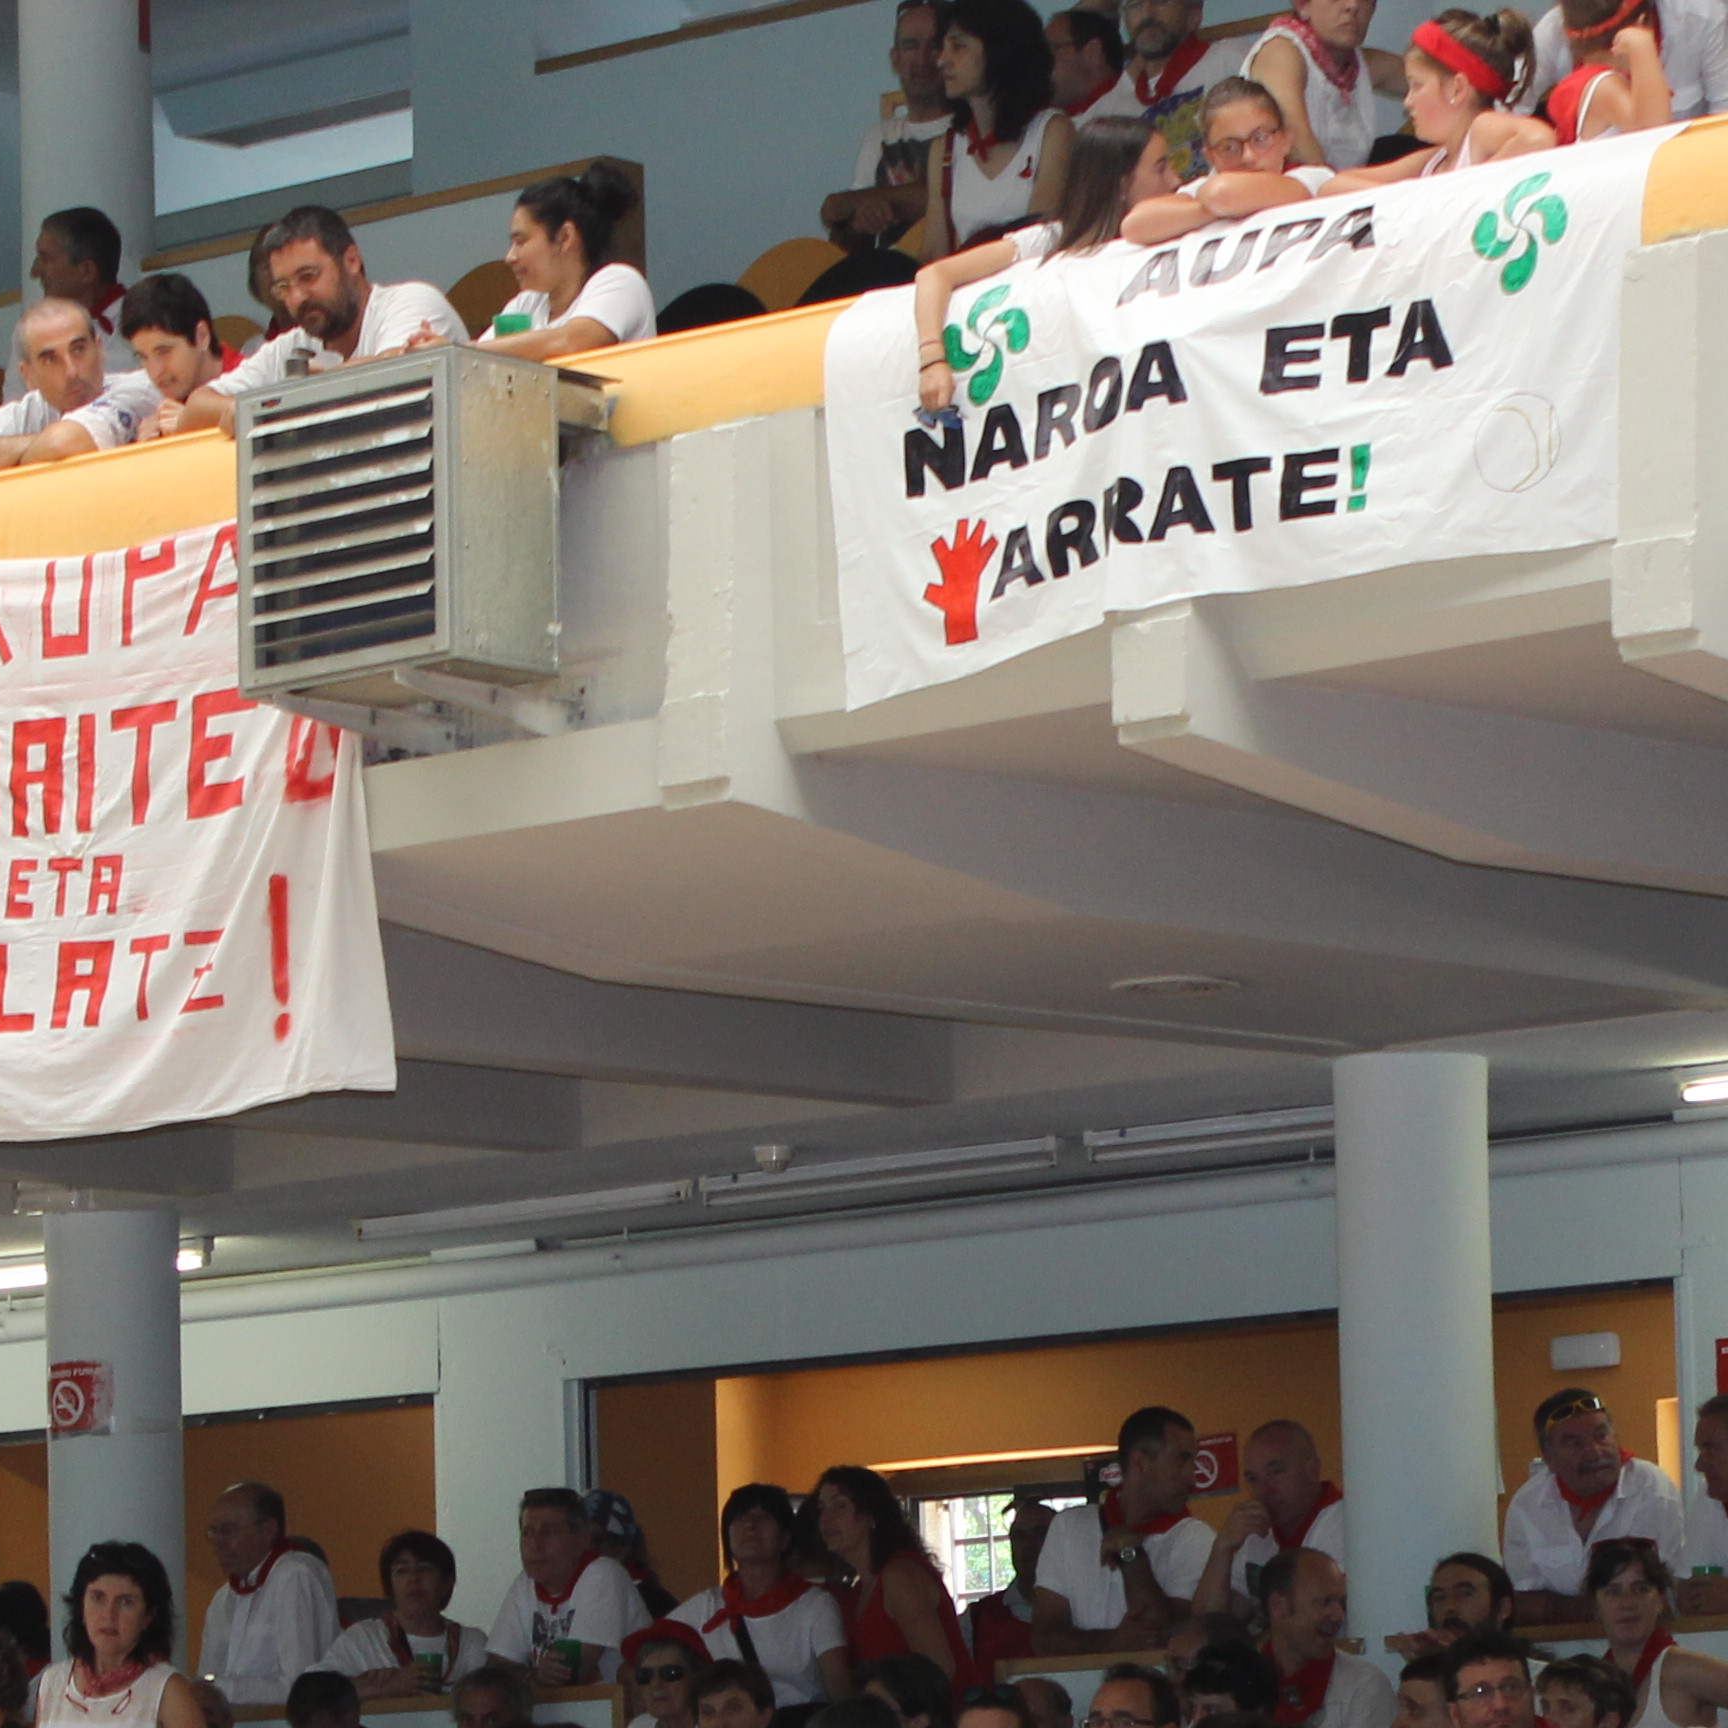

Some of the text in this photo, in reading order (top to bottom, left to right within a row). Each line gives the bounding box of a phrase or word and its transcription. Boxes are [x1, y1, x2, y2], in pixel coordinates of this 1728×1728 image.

[1117, 204, 1378, 307] AUPA
[903, 298, 1454, 498] NAROA ETA
[4, 853, 124, 920] ETA
